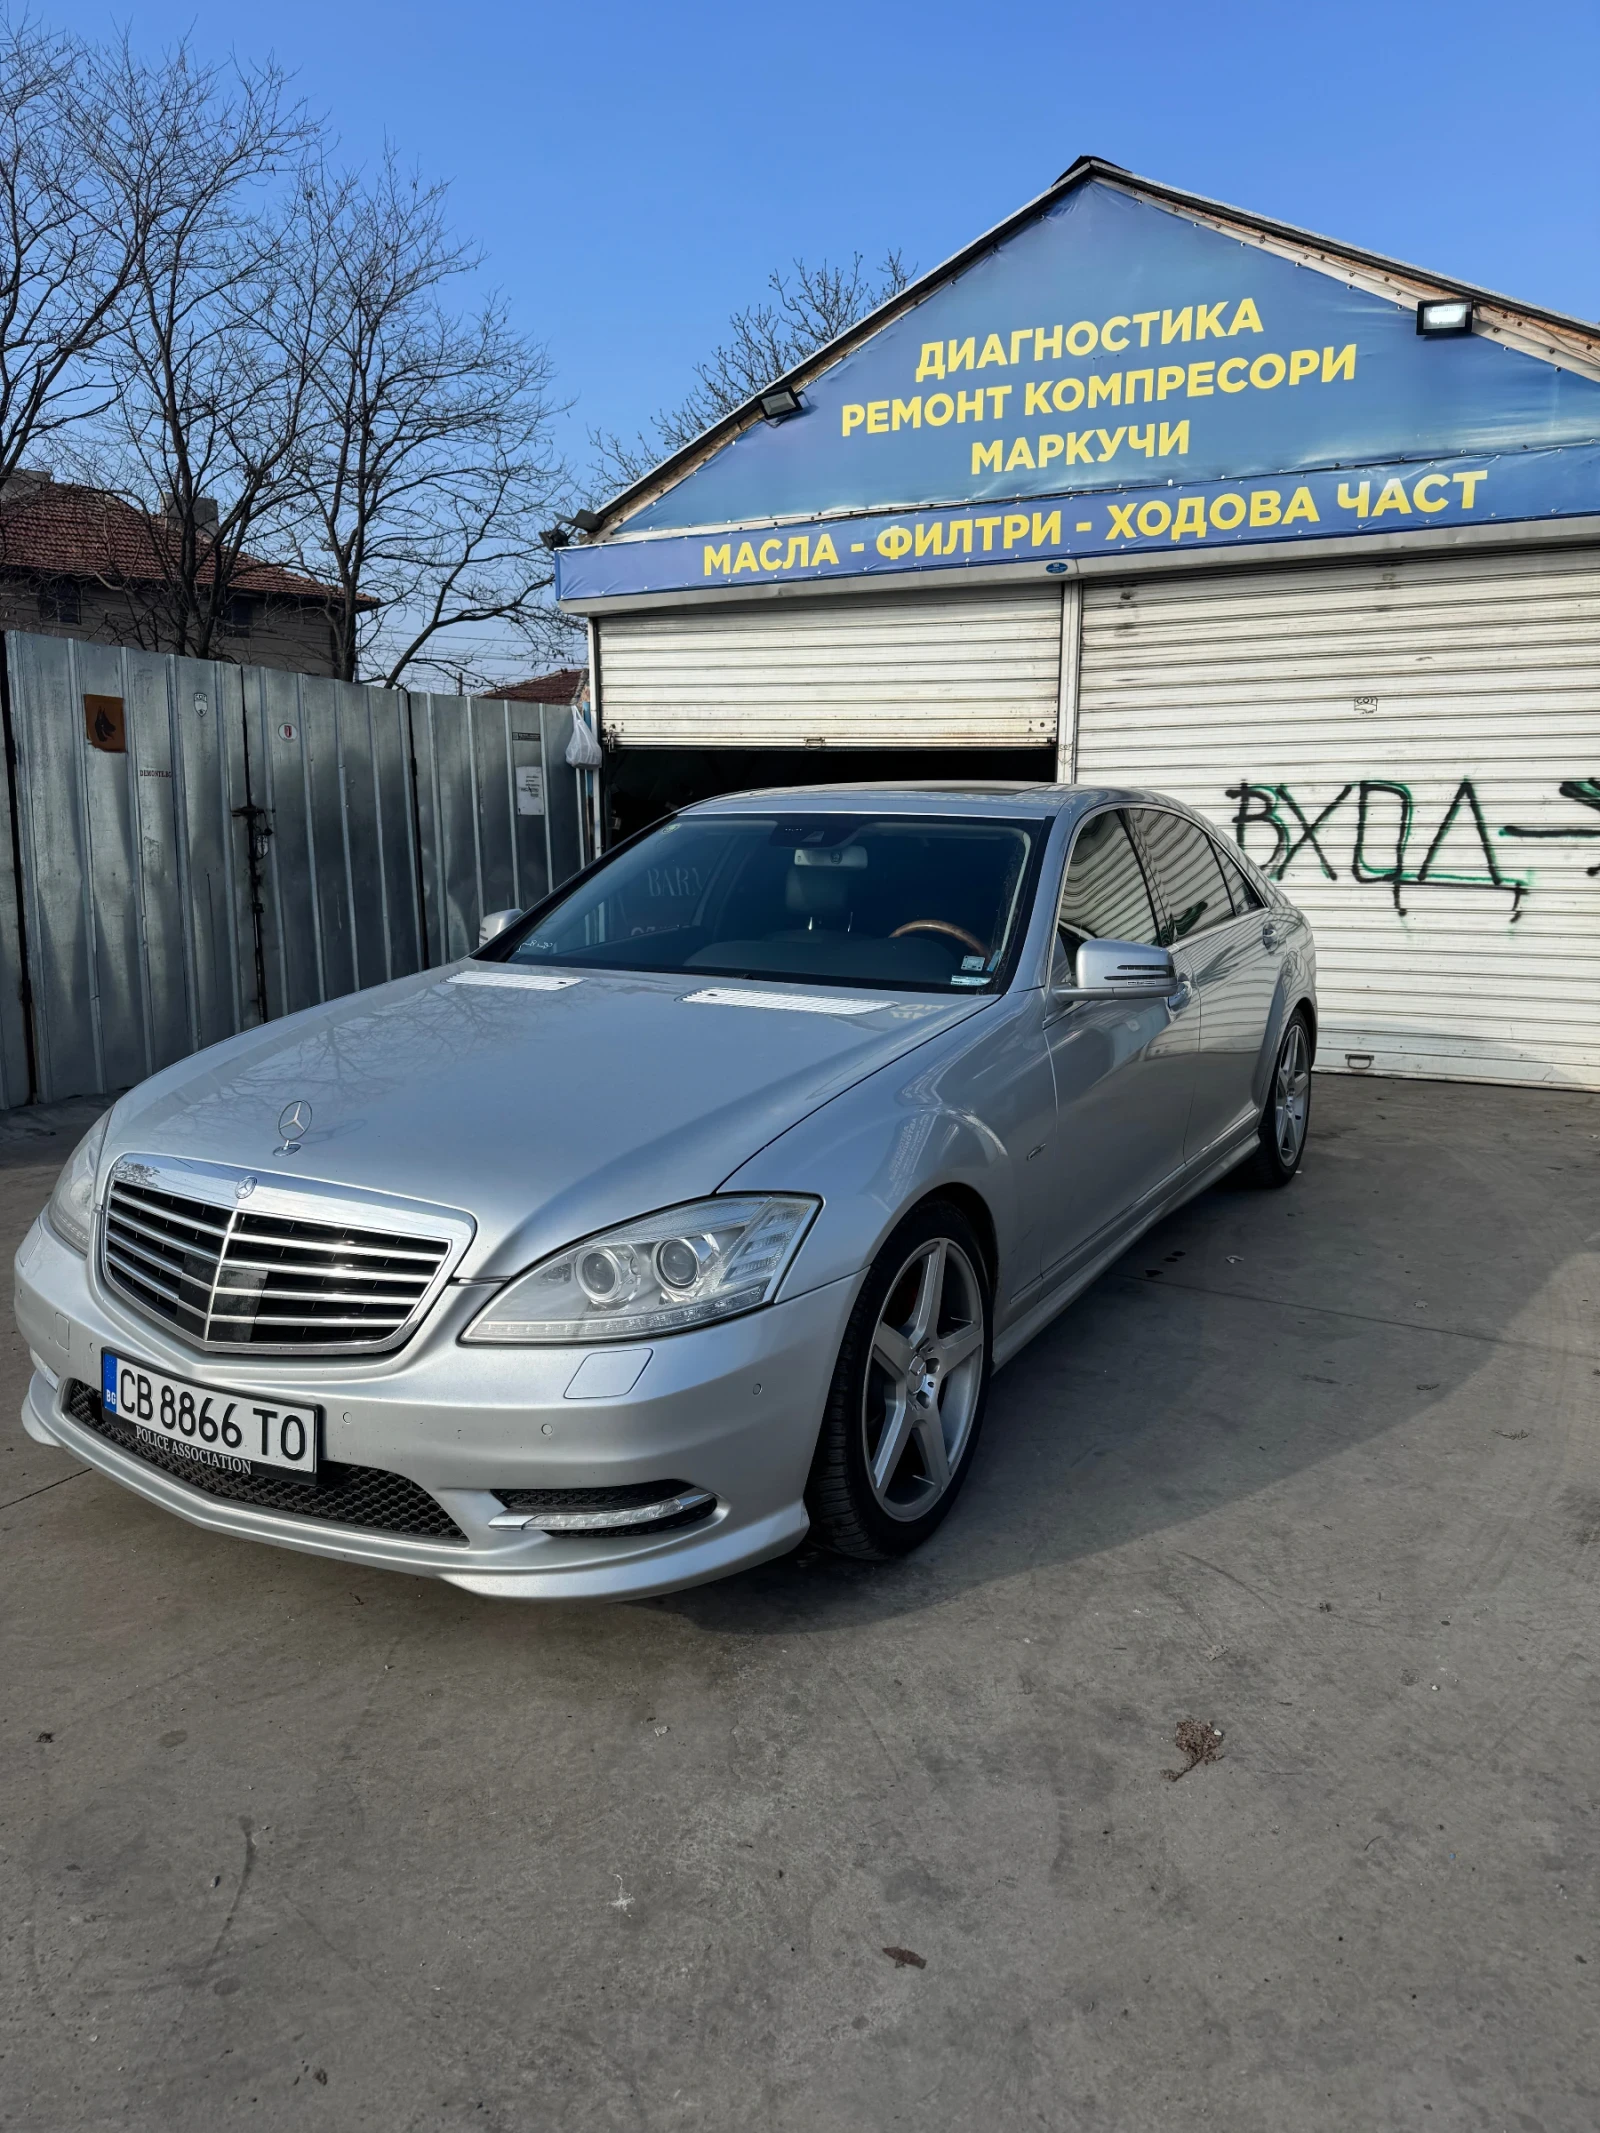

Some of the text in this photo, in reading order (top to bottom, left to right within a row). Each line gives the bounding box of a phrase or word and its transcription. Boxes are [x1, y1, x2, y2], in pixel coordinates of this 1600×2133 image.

[915, 298, 1264, 383] ДИАГНОСТИКА
[842, 344, 1357, 437] РЕМОНТ КОМПРЕСОРИ
[971, 420, 1189, 475] МАРКУЧИ
[703, 533, 839, 576] МАСЛА
[876, 510, 1062, 560] ФИЛТРИ
[1106, 486, 1319, 541] ХОДОВА
[1337, 471, 1487, 518] ЧАСТ
[1225, 778, 1529, 923] ВХОД
[106, 1388, 117, 1405] BG
[120, 1368, 307, 1461] CB 8866 TO
[136, 1424, 252, 1475] POLICE ASSOCIATION
